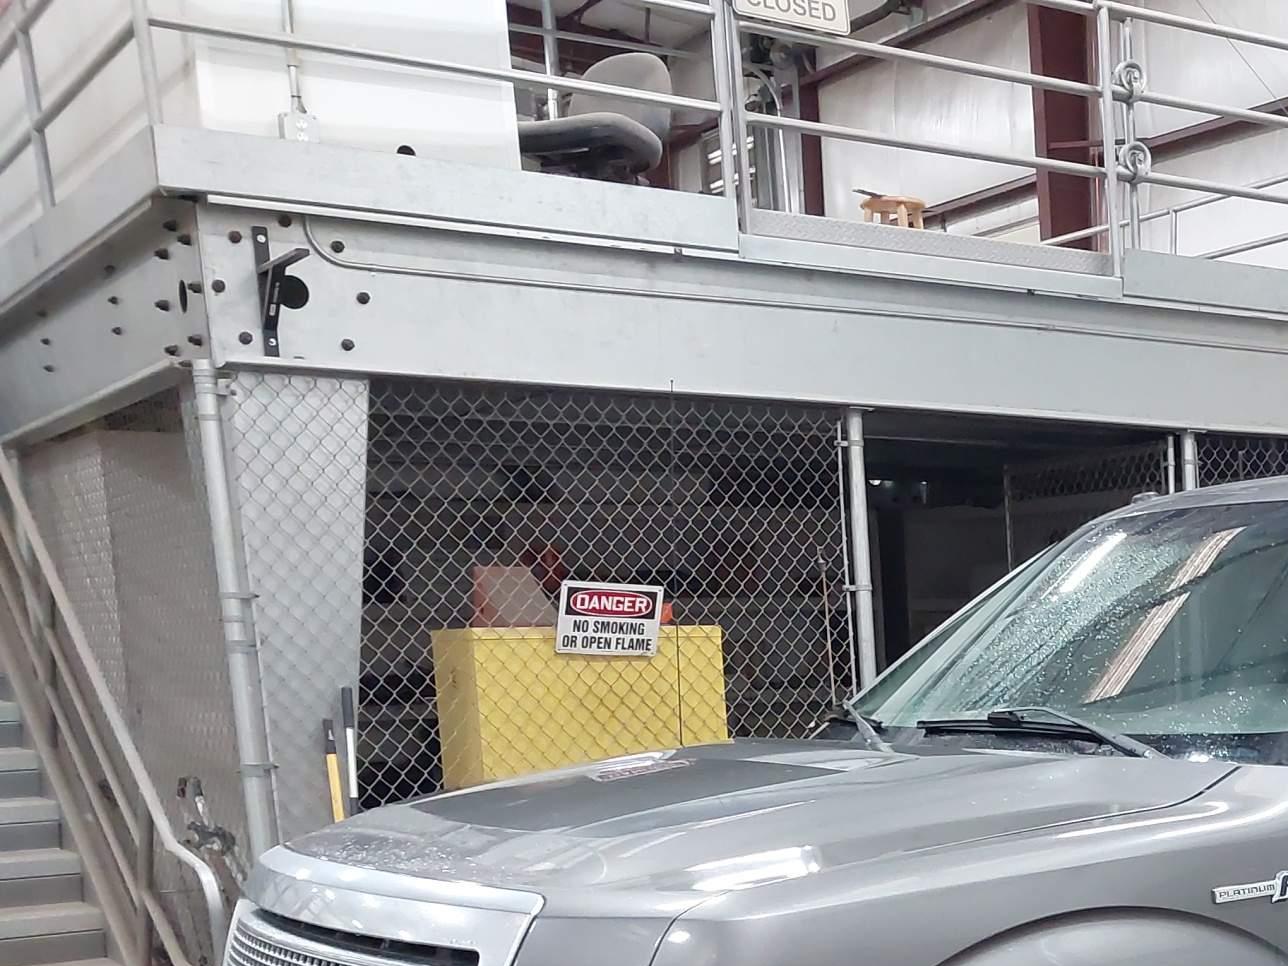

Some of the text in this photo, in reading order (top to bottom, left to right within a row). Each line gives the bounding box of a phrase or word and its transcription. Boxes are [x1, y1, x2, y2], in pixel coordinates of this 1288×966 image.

[576, 594, 648, 613] DANGER
[573, 620, 645, 636] NO SMOKING
[562, 635, 653, 651] OR OPEN FLAME
[1218, 883, 1276, 899] PLATINUM
